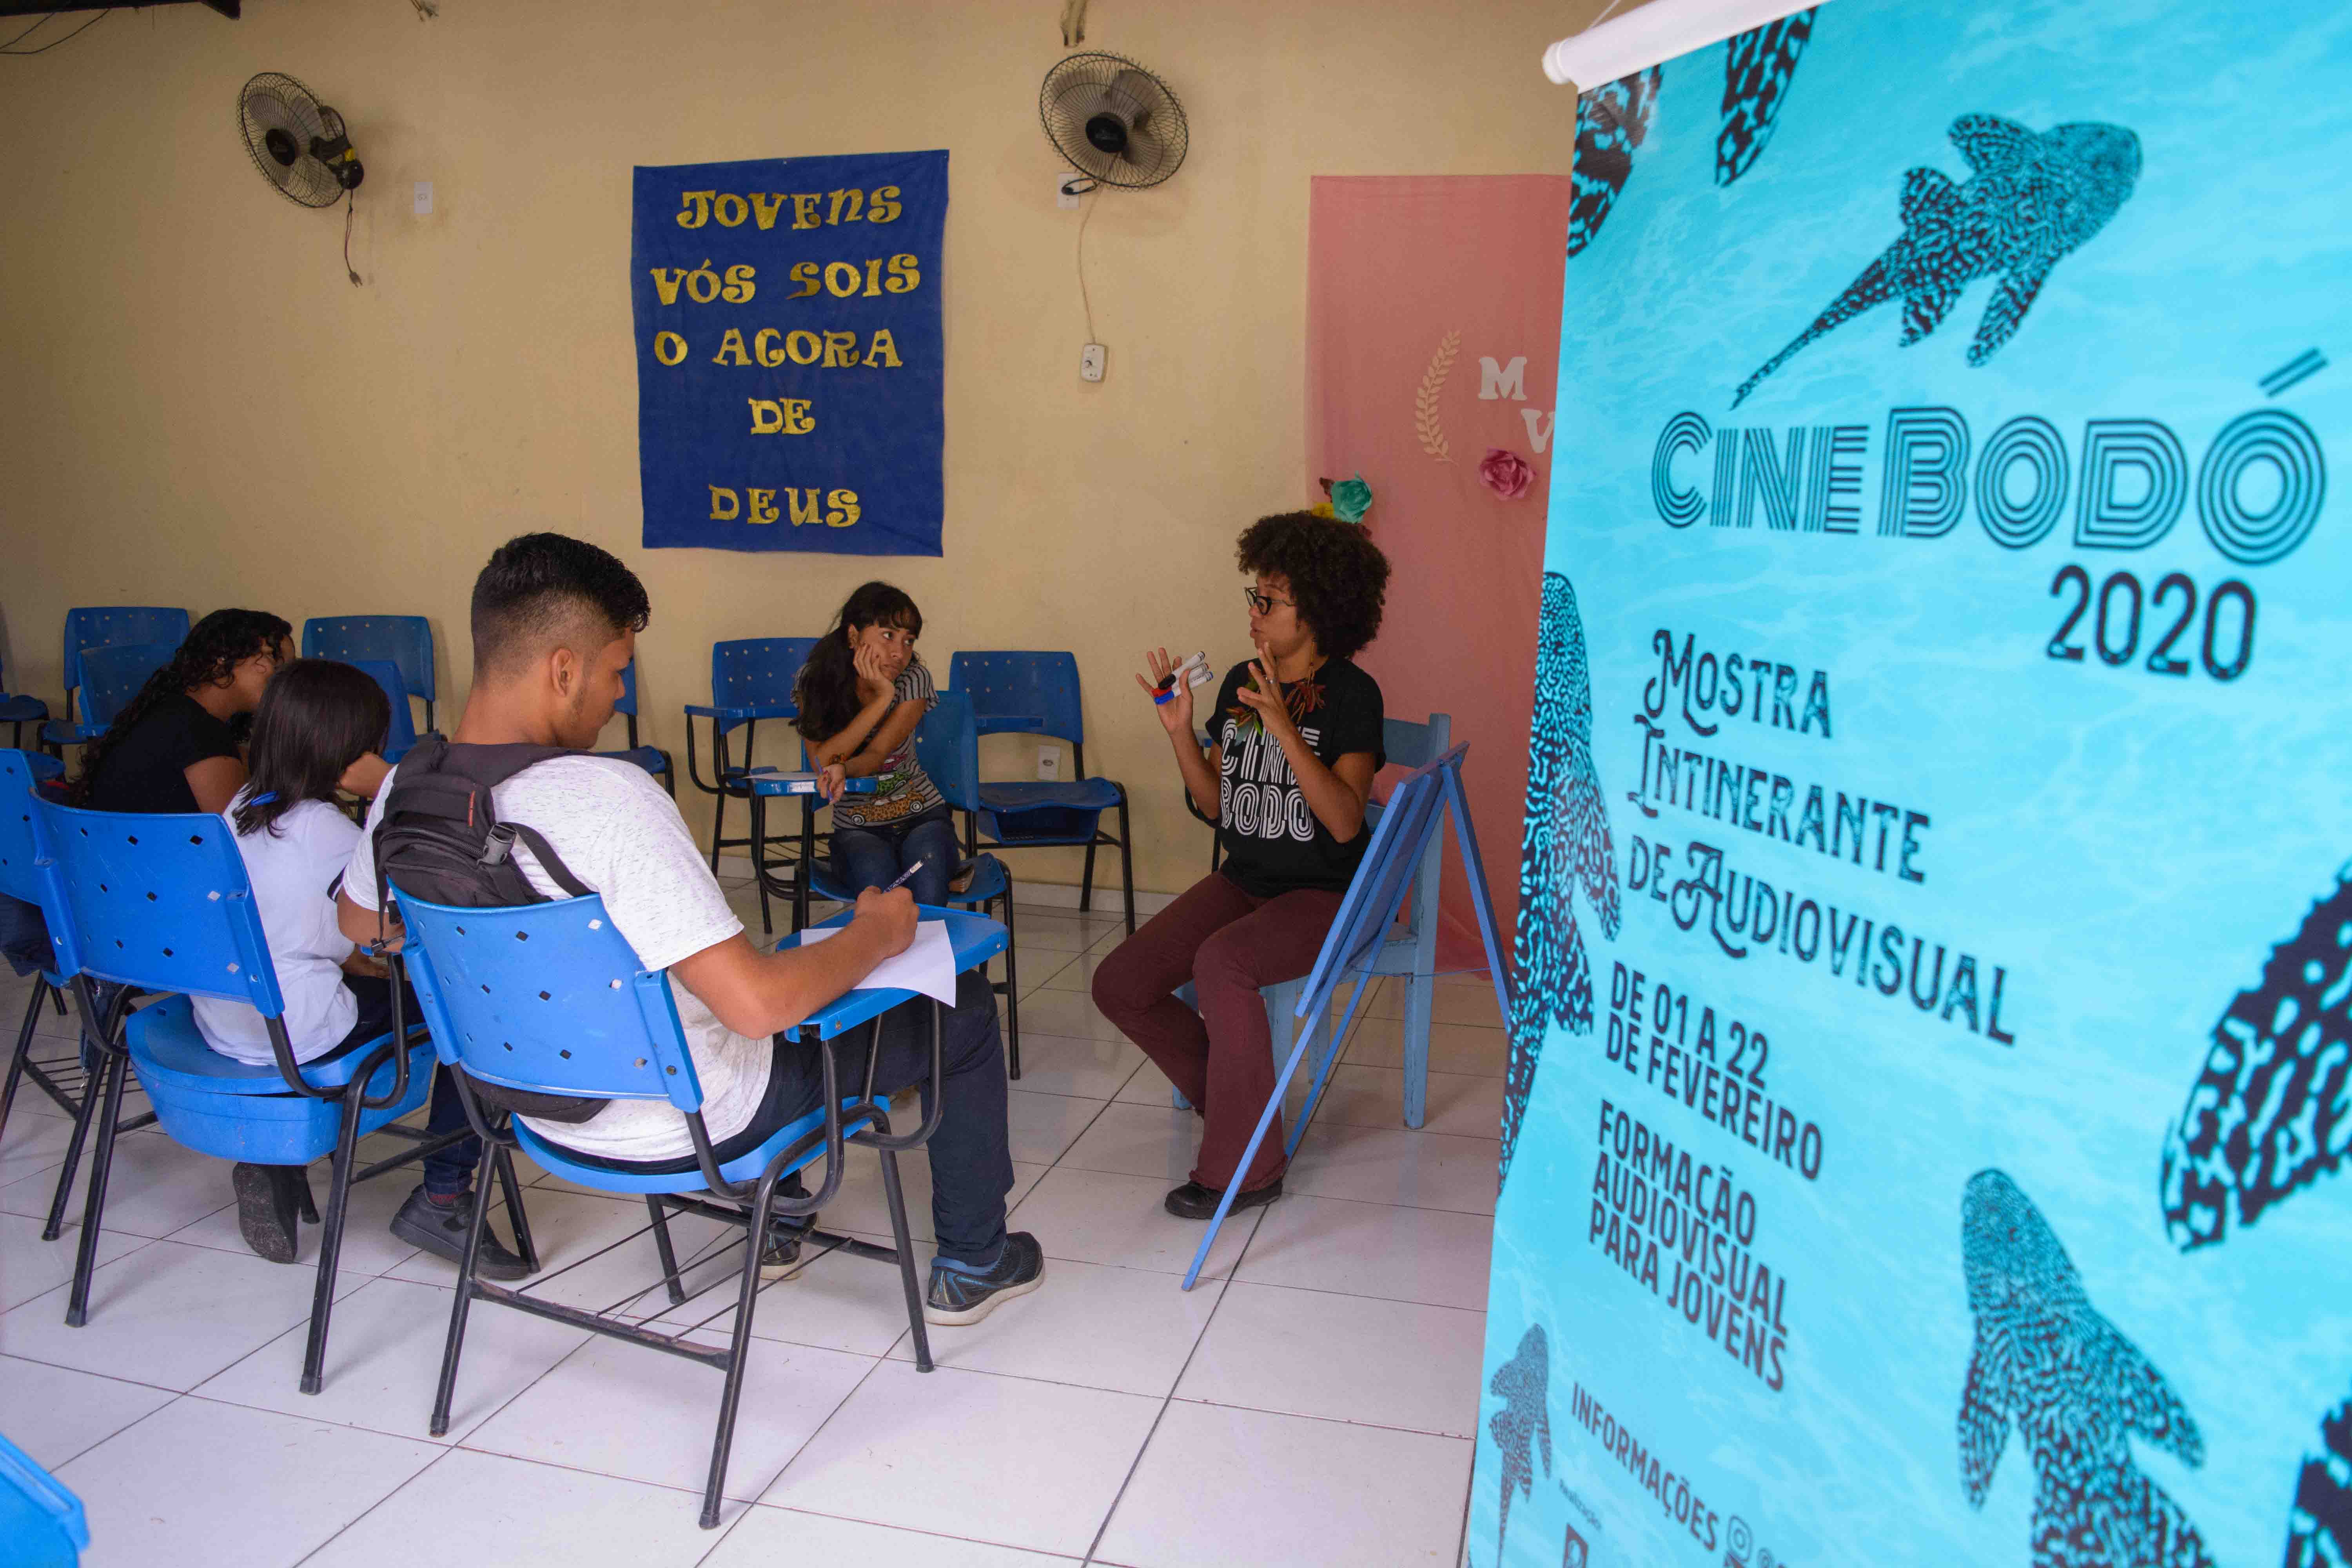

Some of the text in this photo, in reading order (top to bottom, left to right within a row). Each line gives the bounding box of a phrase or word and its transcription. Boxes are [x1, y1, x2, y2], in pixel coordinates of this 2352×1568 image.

[675, 185, 903, 230] JOVENS
[650, 253, 921, 306] VÓS SOIS
[654, 328, 903, 368] O AGORA
[747, 397, 816, 435] DE
[708, 483, 862, 527] DEUS
[2045, 564, 2257, 684] 2020
[1628, 835, 2016, 1046] DE AUDIOVISUAL
[1611, 960, 1769, 1090] DE 01 A 22
[1606, 1011, 1822, 1180] DE FEVEREIRO
[1598, 1099, 1756, 1246] FORMAÇÃO
[1588, 1198, 1787, 1392] PARA JOVENS
[1592, 1151, 1788, 1336] AUDIOVISUAL
[1571, 1381, 1719, 1552] INFORMAÇÕES
